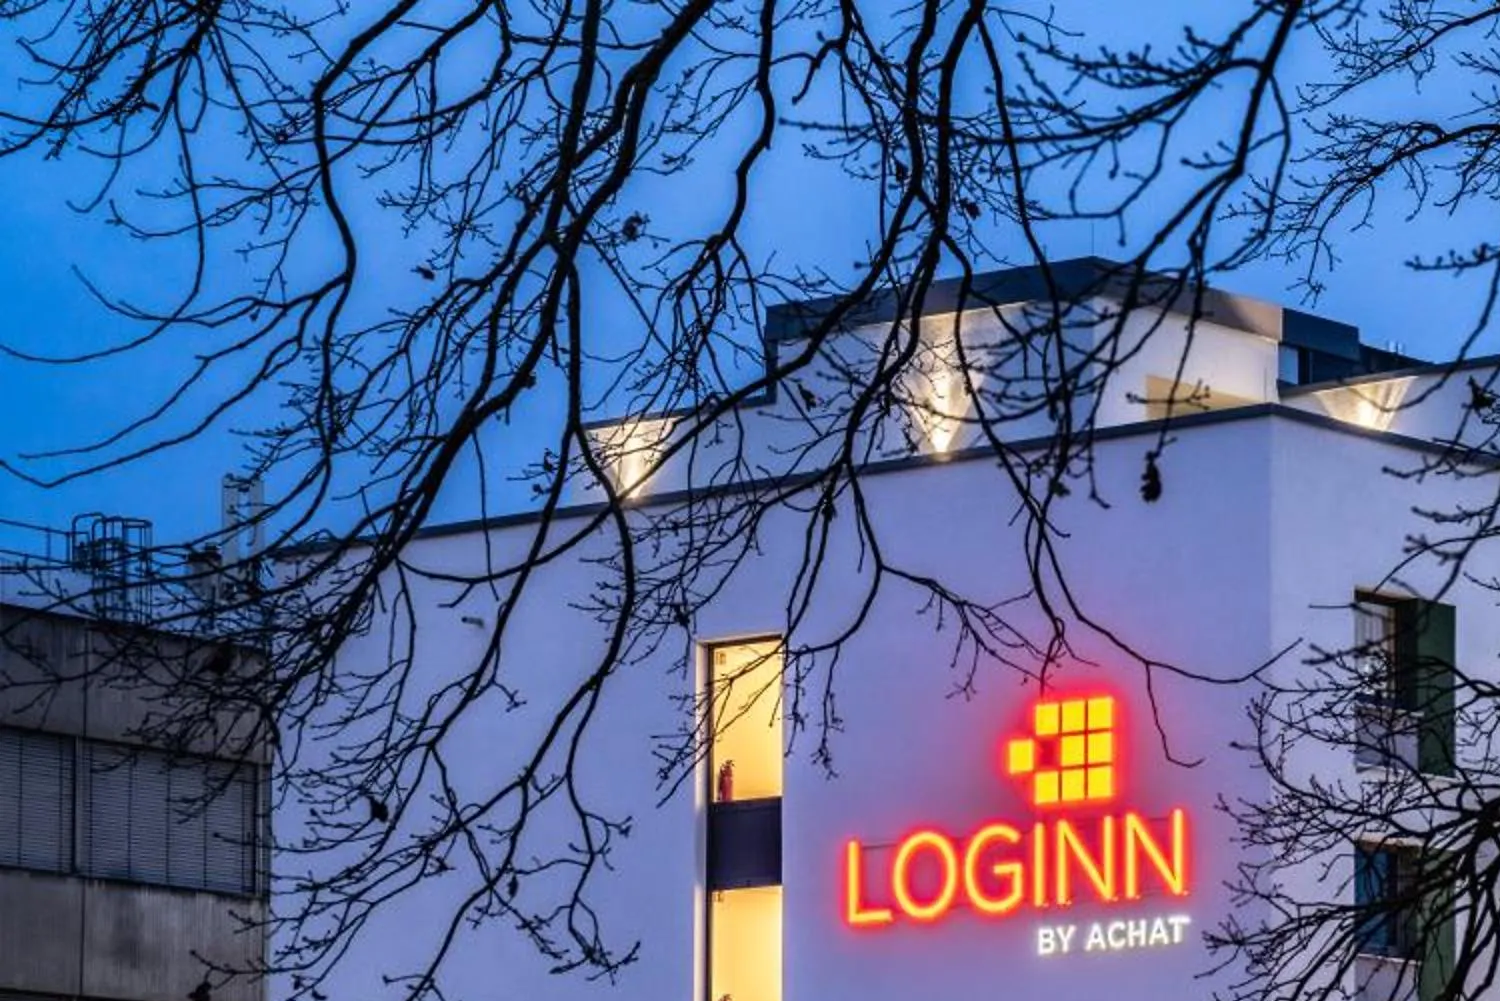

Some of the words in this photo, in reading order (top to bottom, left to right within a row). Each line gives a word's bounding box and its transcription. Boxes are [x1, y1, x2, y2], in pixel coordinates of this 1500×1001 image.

[847, 808, 1183, 924] LOGINN
[1037, 925, 1075, 956] BY
[1085, 915, 1191, 953] ACHAT
